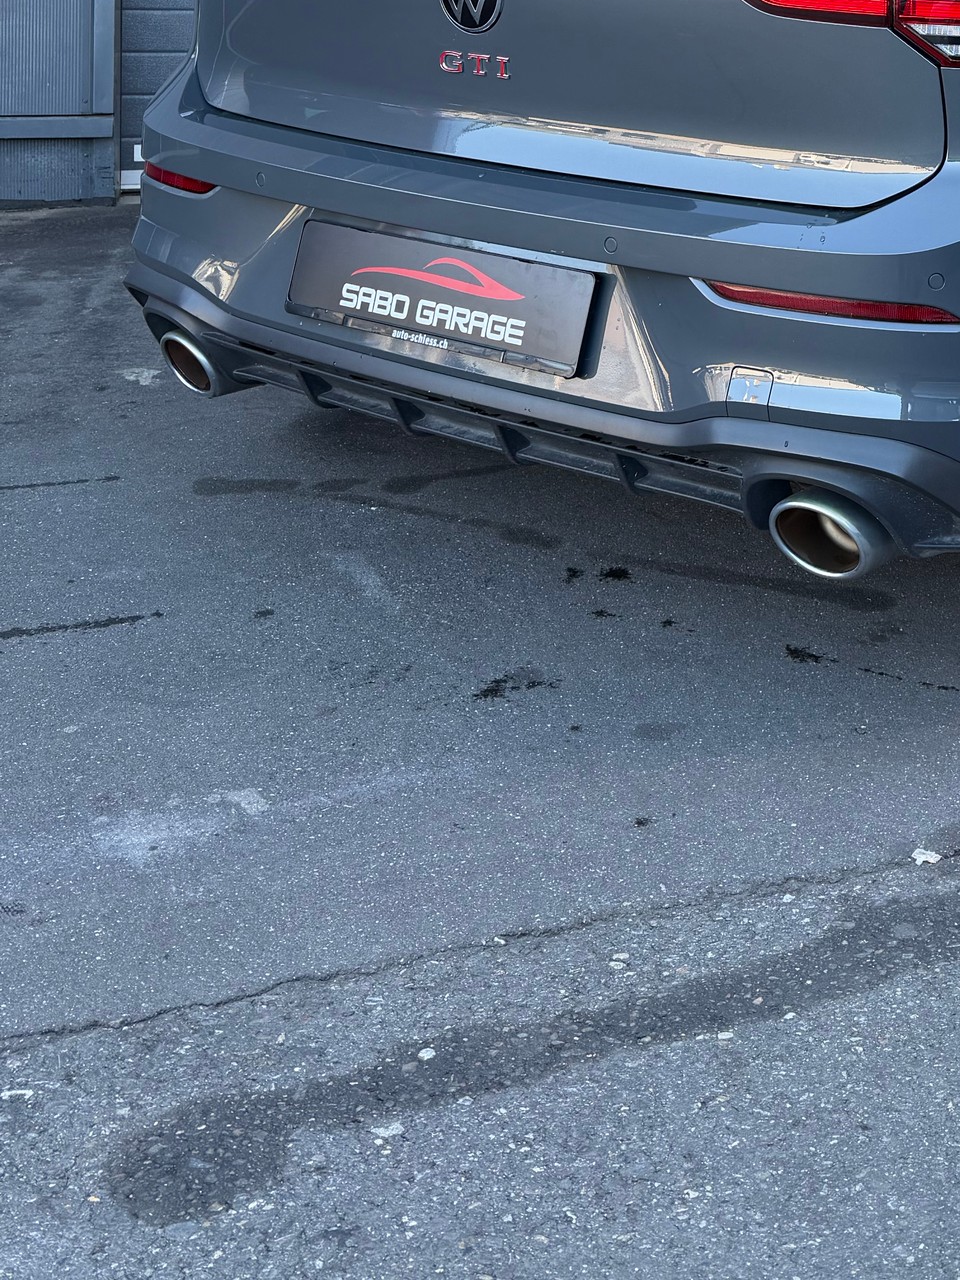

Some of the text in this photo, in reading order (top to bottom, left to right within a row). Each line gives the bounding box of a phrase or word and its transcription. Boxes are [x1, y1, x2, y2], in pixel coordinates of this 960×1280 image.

[439, 50, 511, 80] GTI
[339, 282, 527, 347] SABO GARAGE
